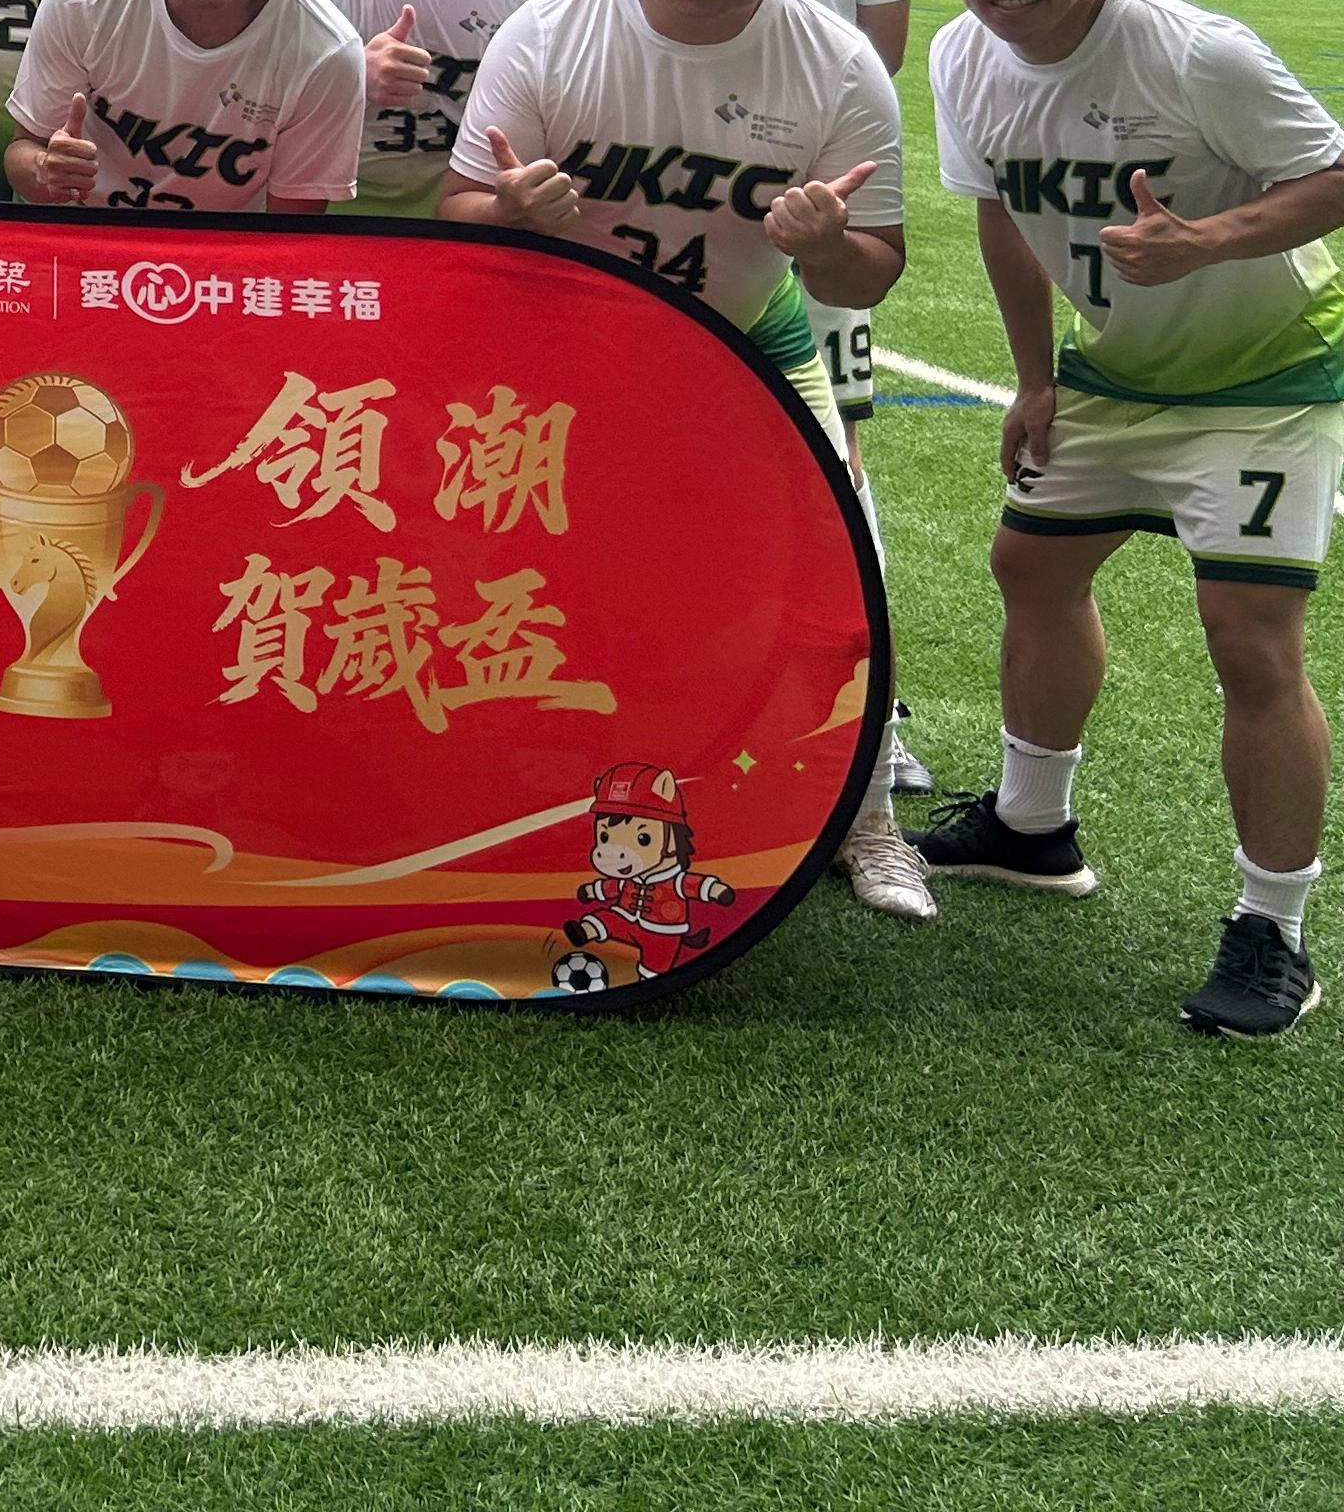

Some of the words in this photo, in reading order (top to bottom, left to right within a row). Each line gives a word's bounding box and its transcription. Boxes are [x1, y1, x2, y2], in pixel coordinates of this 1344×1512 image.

[559, 140, 799, 224] HKIC
[80, 261, 381, 324] 愛心中建幸福
[824, 323, 873, 386] 19
[180, 371, 577, 536] 領潮
[1238, 469, 1286, 538] 7
[211, 553, 617, 734] 賀歲盃
